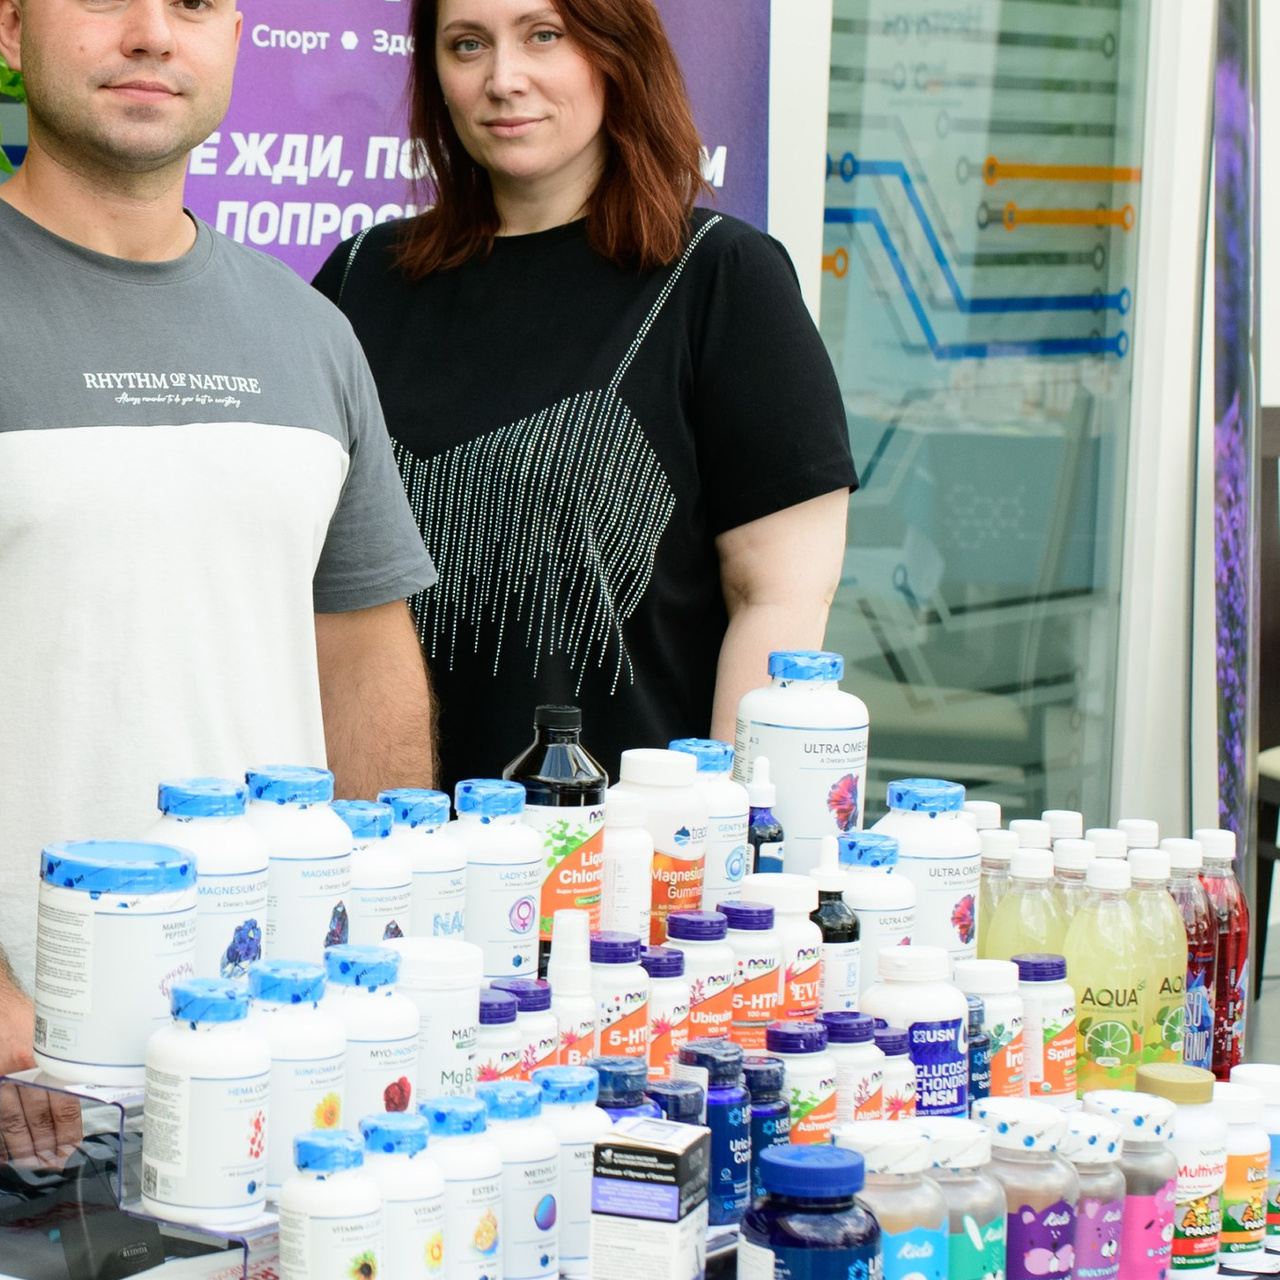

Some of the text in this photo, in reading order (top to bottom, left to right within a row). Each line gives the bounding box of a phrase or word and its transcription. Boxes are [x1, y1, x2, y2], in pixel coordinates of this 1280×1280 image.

[251, 25, 331, 54] Спорт
[225, 132, 354, 187] ЖДИ,
[83, 372, 261, 394] RHYTHM OF NATURE
[804, 743, 840, 754] ULTRA
[499, 870, 527, 881] LADY'S
[929, 867, 960, 877] ULTRA
[197, 883, 256, 897] MAGNESIUM
[748, 958, 775, 970] now
[1081, 987, 1138, 1008] AQUA
[926, 1028, 956, 1044] USN
[896, 1241, 935, 1260] Kids
